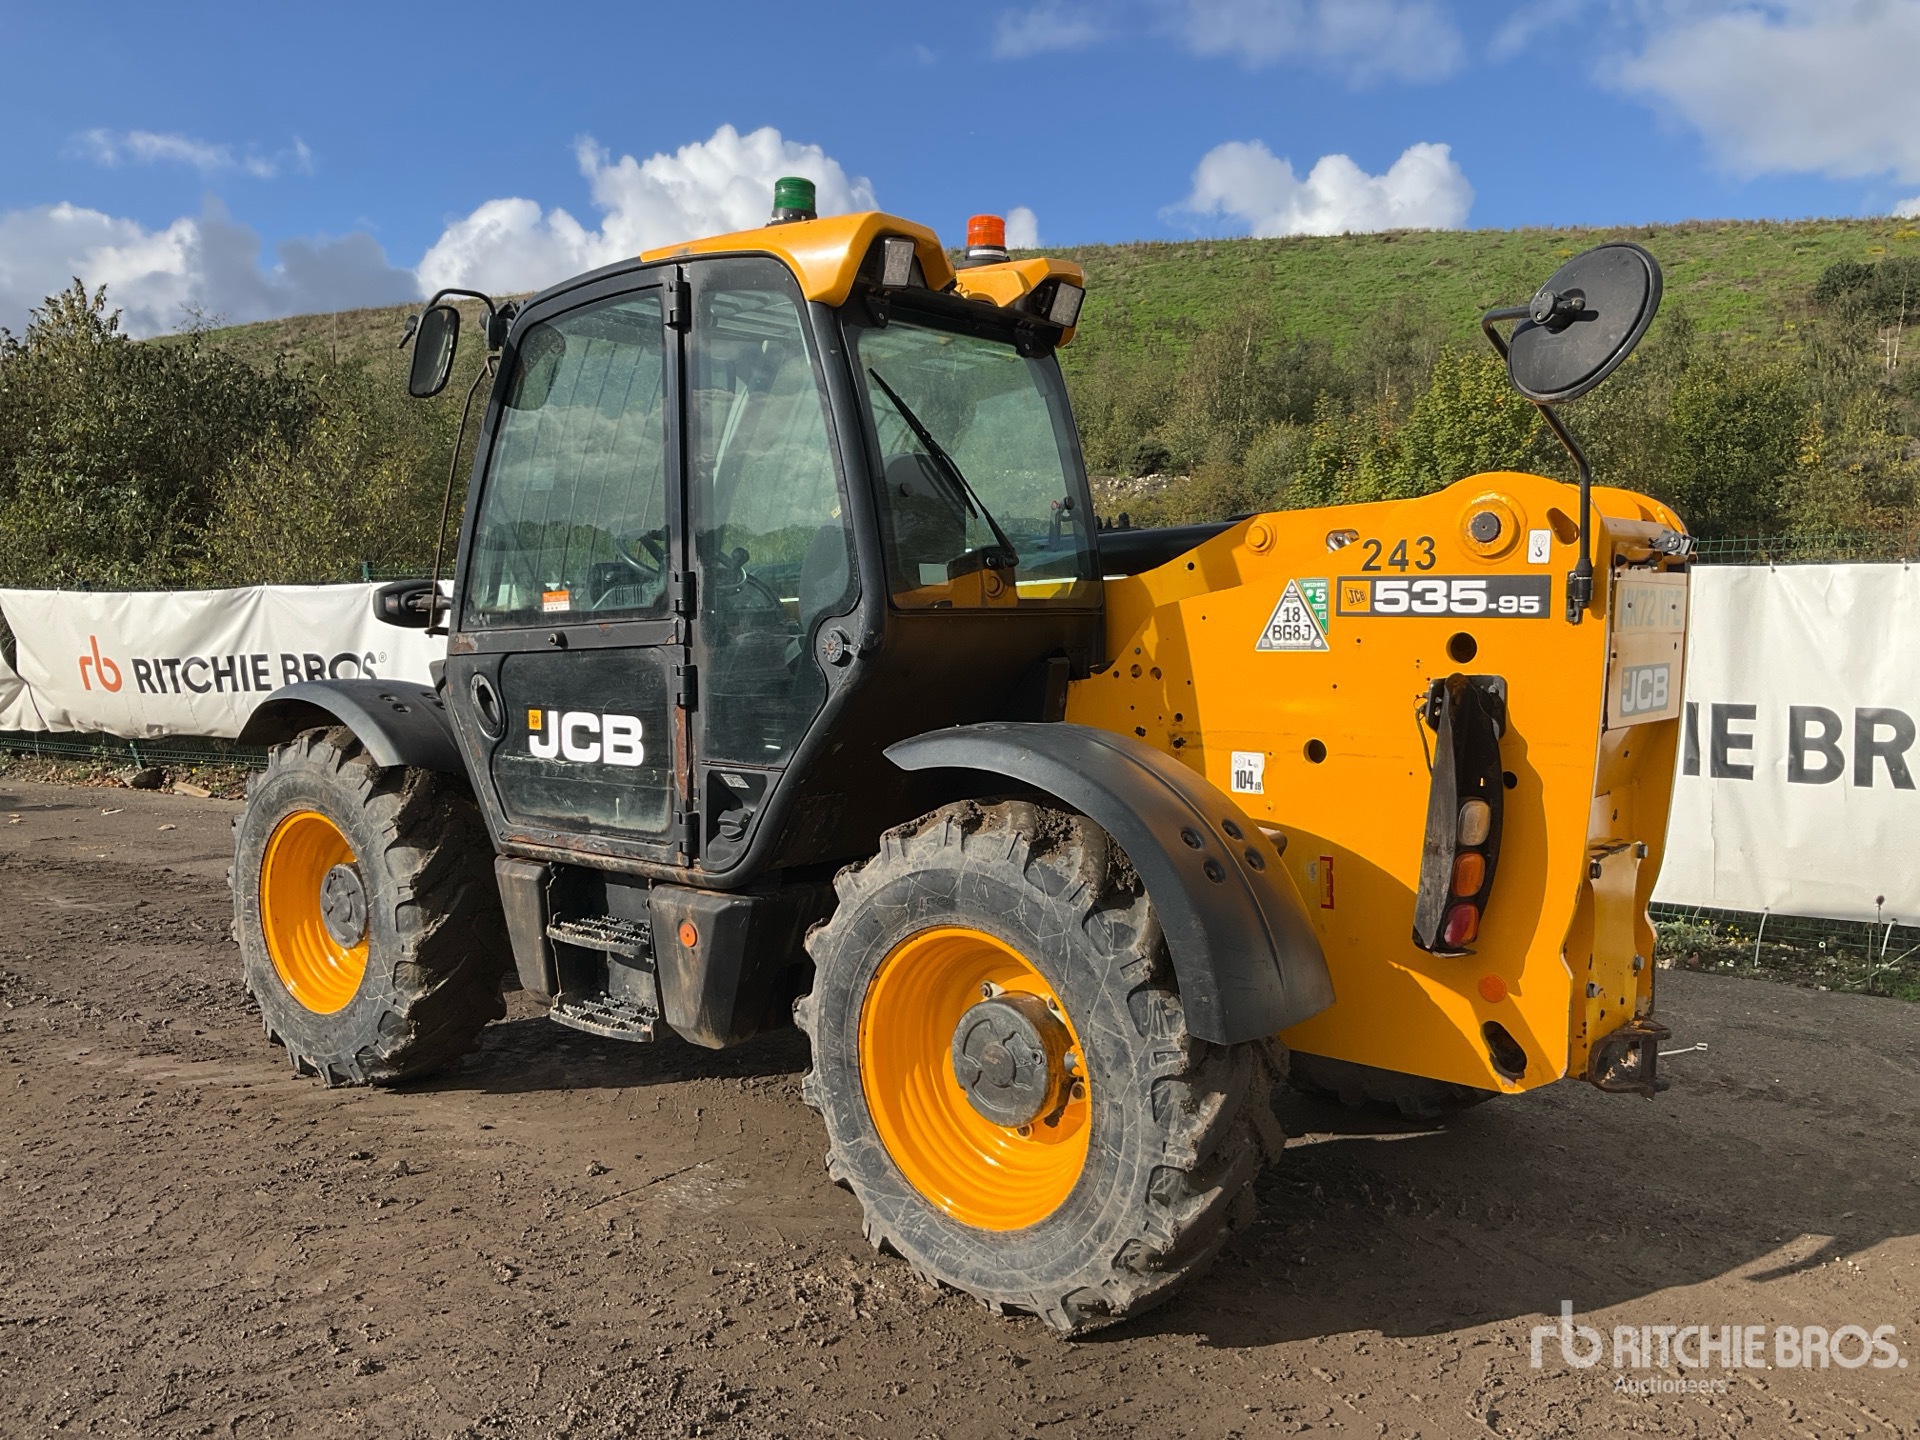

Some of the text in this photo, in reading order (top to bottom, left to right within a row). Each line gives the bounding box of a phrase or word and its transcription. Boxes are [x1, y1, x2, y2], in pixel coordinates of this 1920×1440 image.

[1362, 536, 1436, 572] 243
[1283, 606, 1301, 622] 18
[1349, 589, 1366, 604] JCB
[1272, 624, 1311, 641] BG8J
[131, 653, 272, 693] RITCHIE
[1622, 667, 1668, 712] JCB
[529, 710, 644, 767] JCB
[1787, 705, 1916, 790] BR
[1235, 770, 1253, 790] 104
